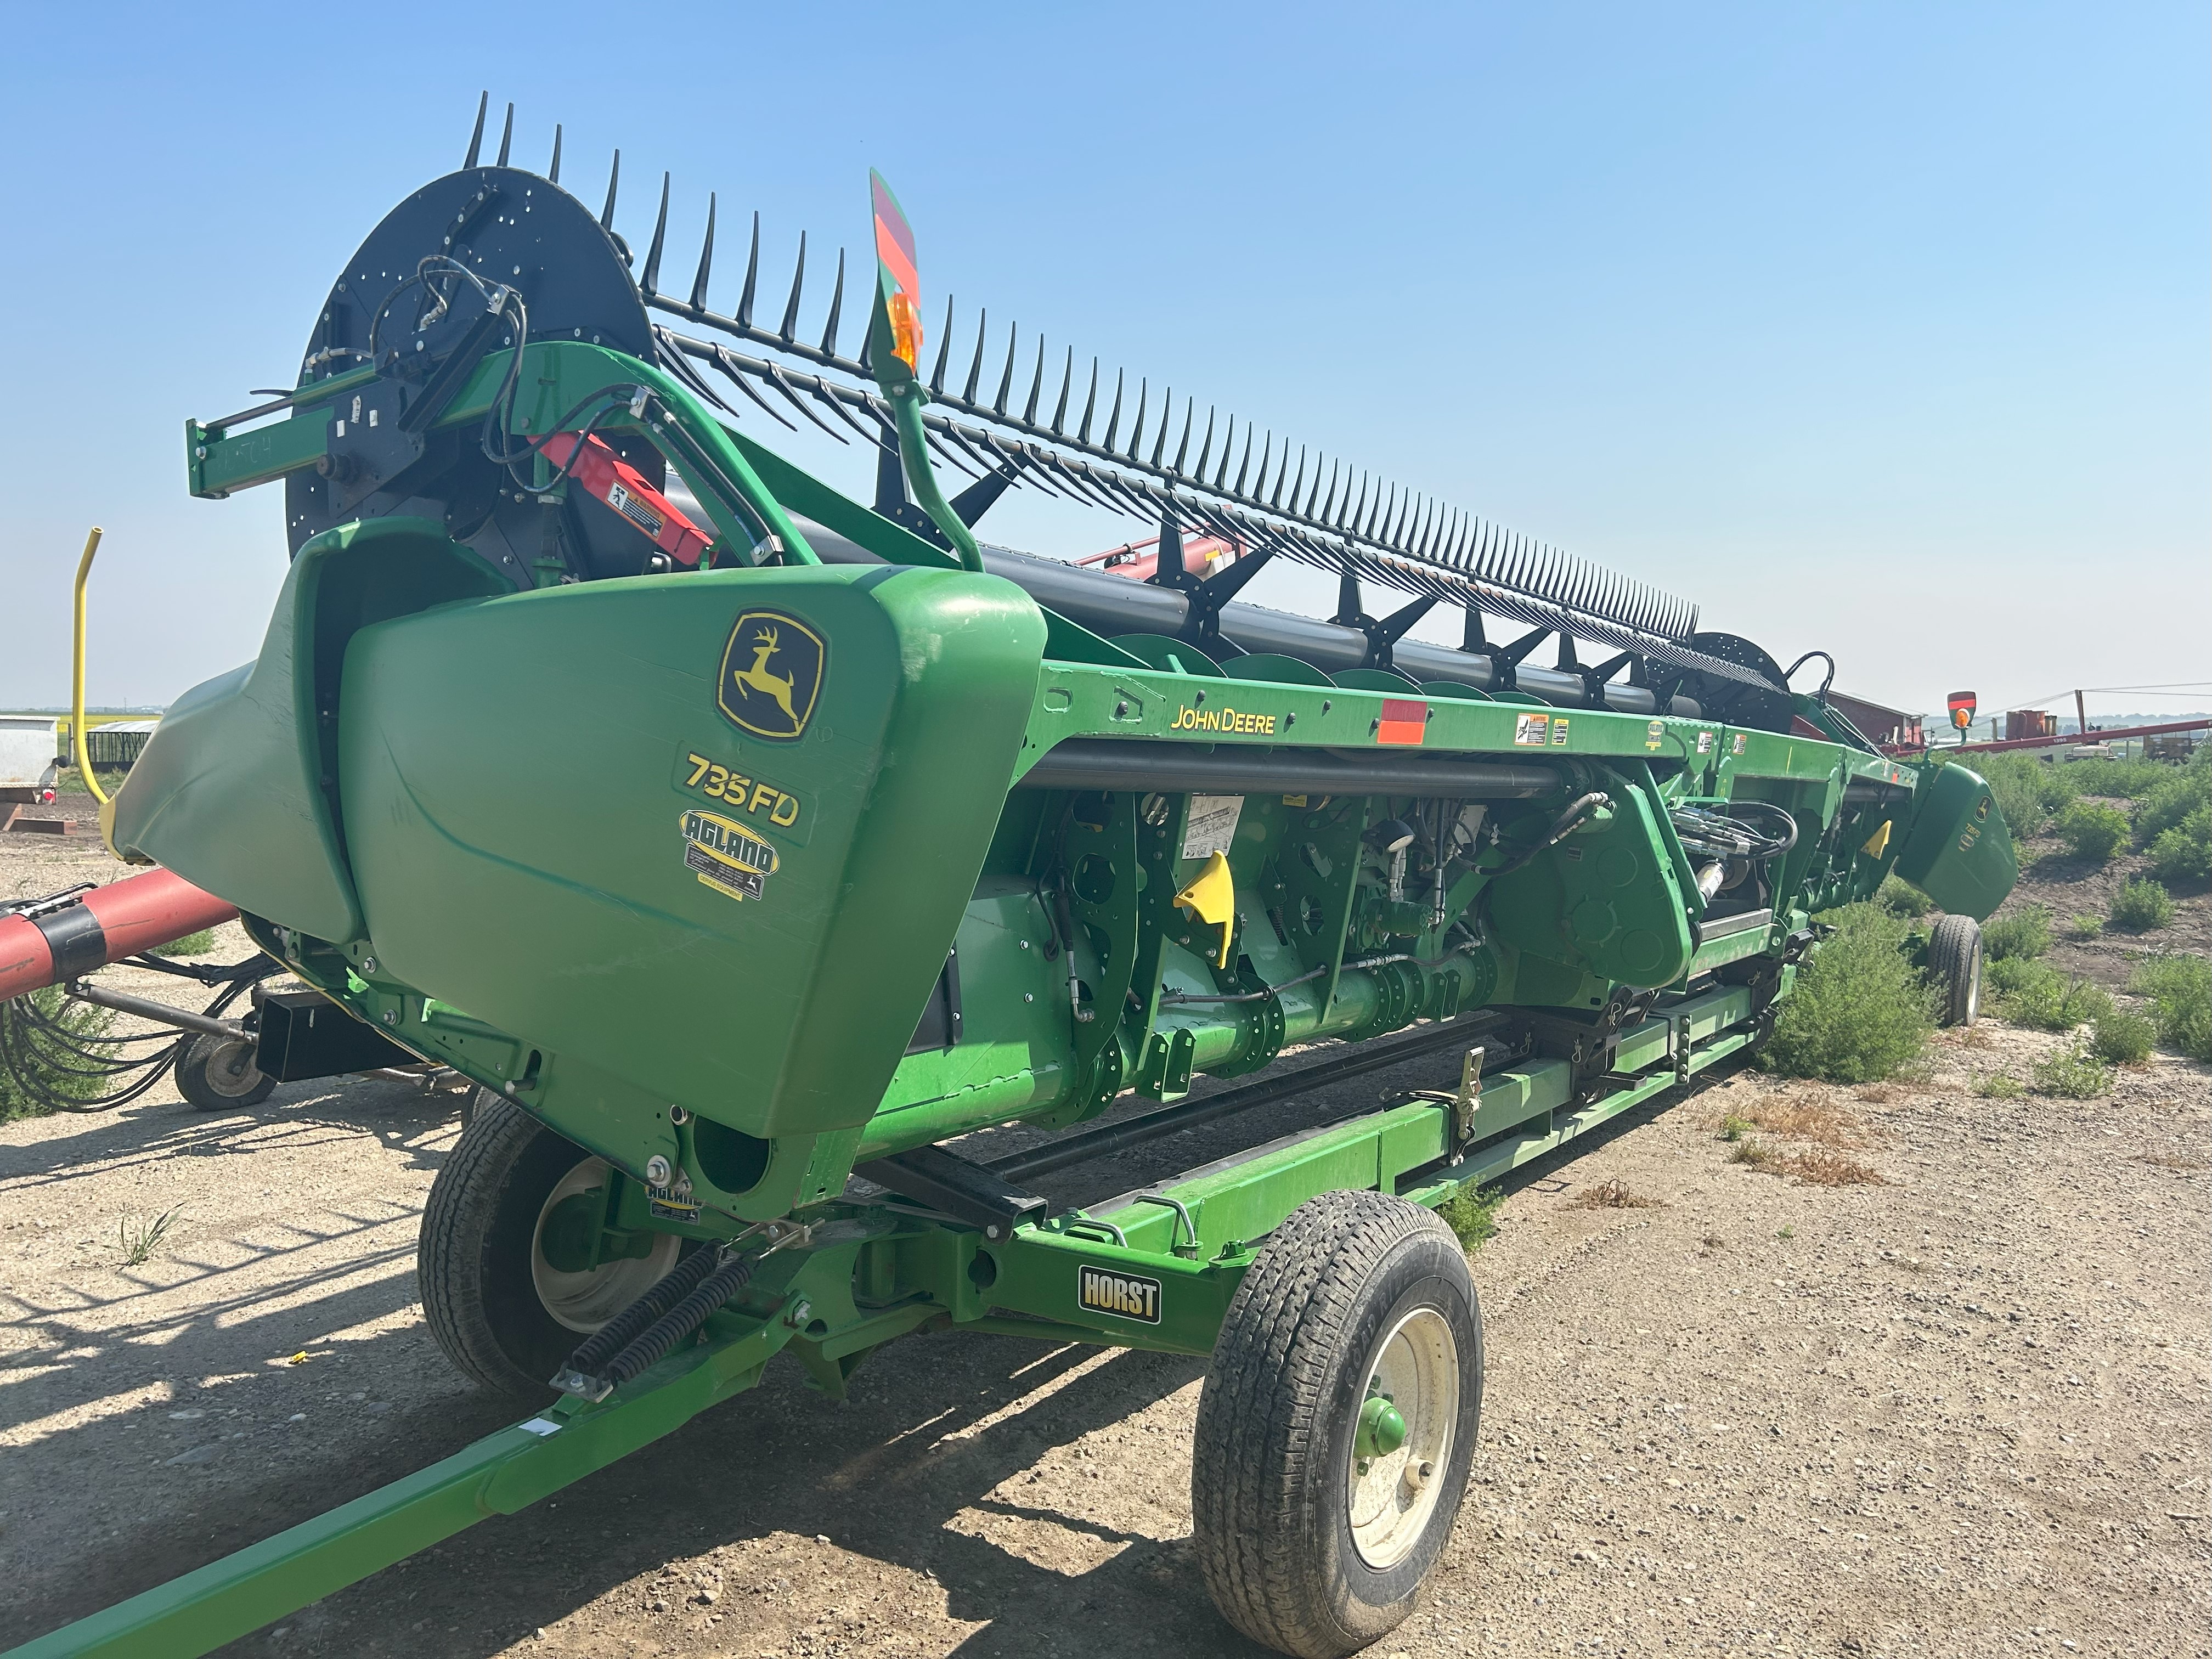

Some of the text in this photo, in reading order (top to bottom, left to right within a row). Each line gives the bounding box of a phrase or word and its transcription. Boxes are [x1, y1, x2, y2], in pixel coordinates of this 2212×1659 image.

[1171, 704, 1276, 734] JOHN DEERE
[684, 811, 775, 874] AGLAND
[1085, 1272, 1157, 1317] HORST
